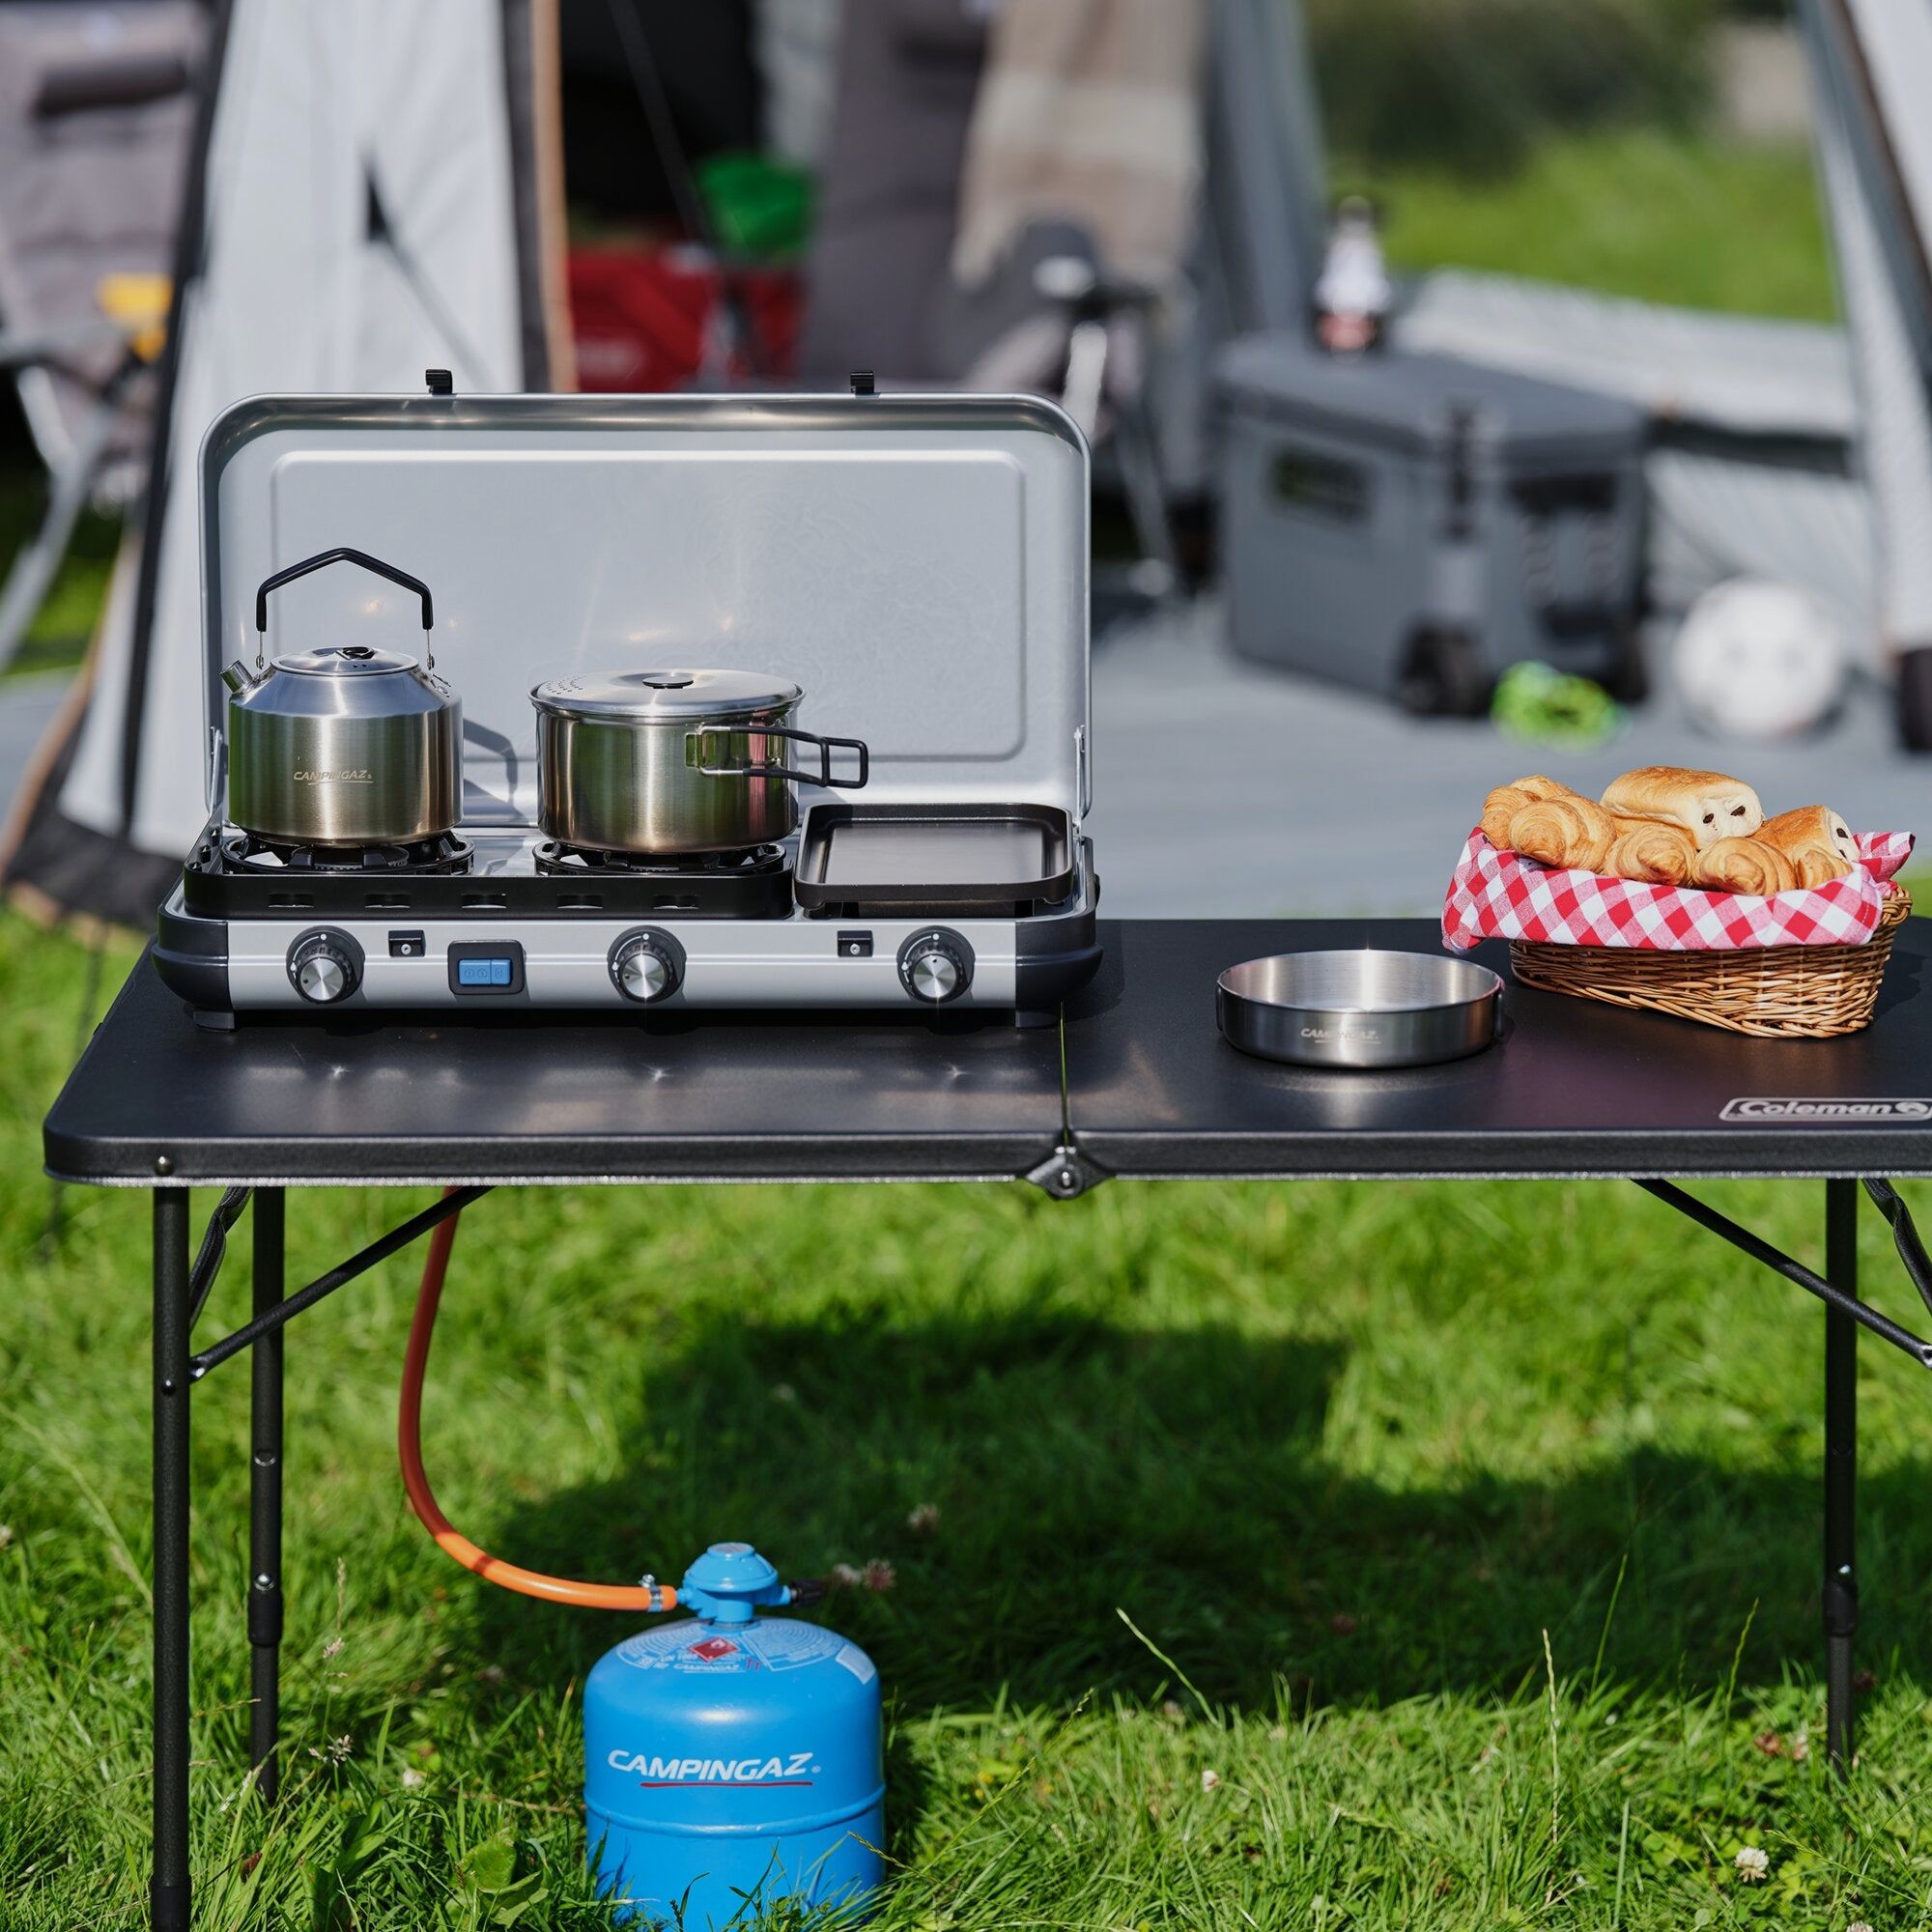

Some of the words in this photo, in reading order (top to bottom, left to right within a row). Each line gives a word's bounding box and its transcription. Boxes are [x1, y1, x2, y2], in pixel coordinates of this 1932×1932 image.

[293, 770, 368, 781] CAMPIGAZ
[1739, 1100, 1890, 1115] Coleman
[608, 1749, 813, 1780] CAMPINGAZ
